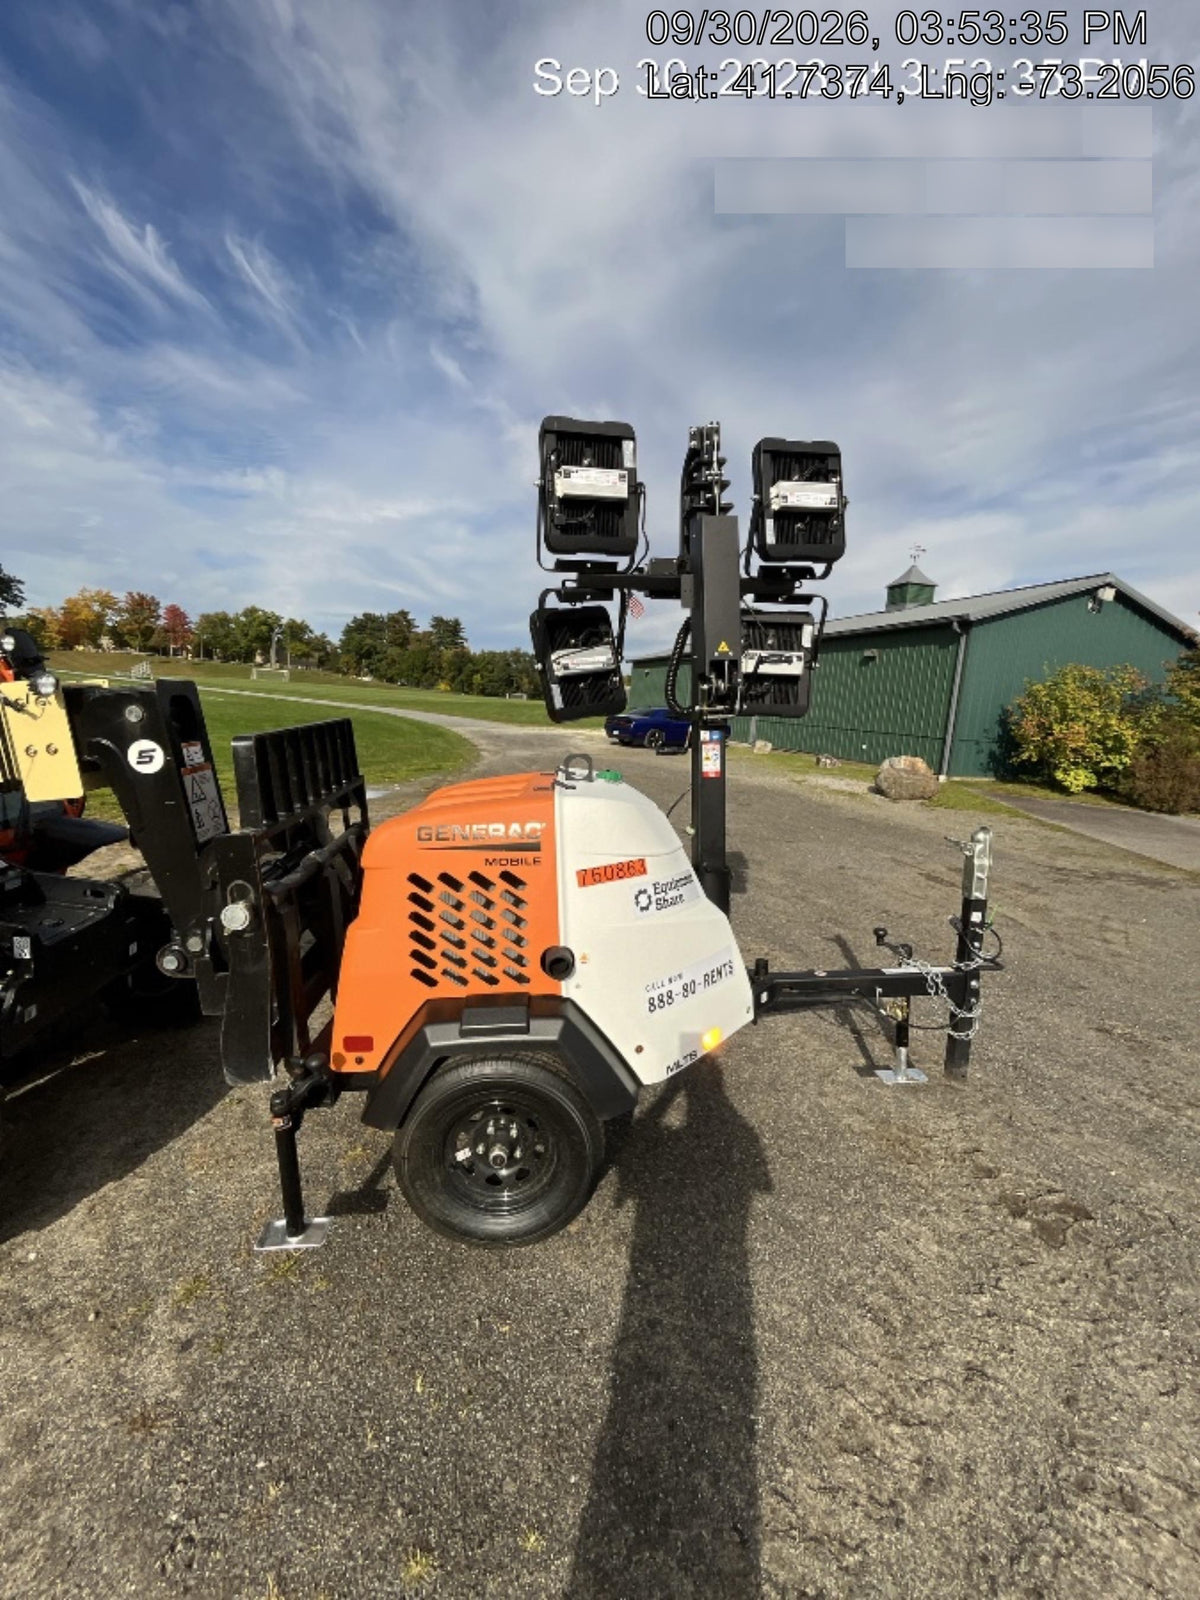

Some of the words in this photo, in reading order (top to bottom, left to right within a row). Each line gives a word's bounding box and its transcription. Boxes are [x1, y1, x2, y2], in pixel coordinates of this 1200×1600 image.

[416, 822, 542, 842] GENERAC
[484, 857, 542, 867] MOBILE
[579, 858, 647, 887] 760863
[648, 959, 734, 1014] 888-80-RENTS
